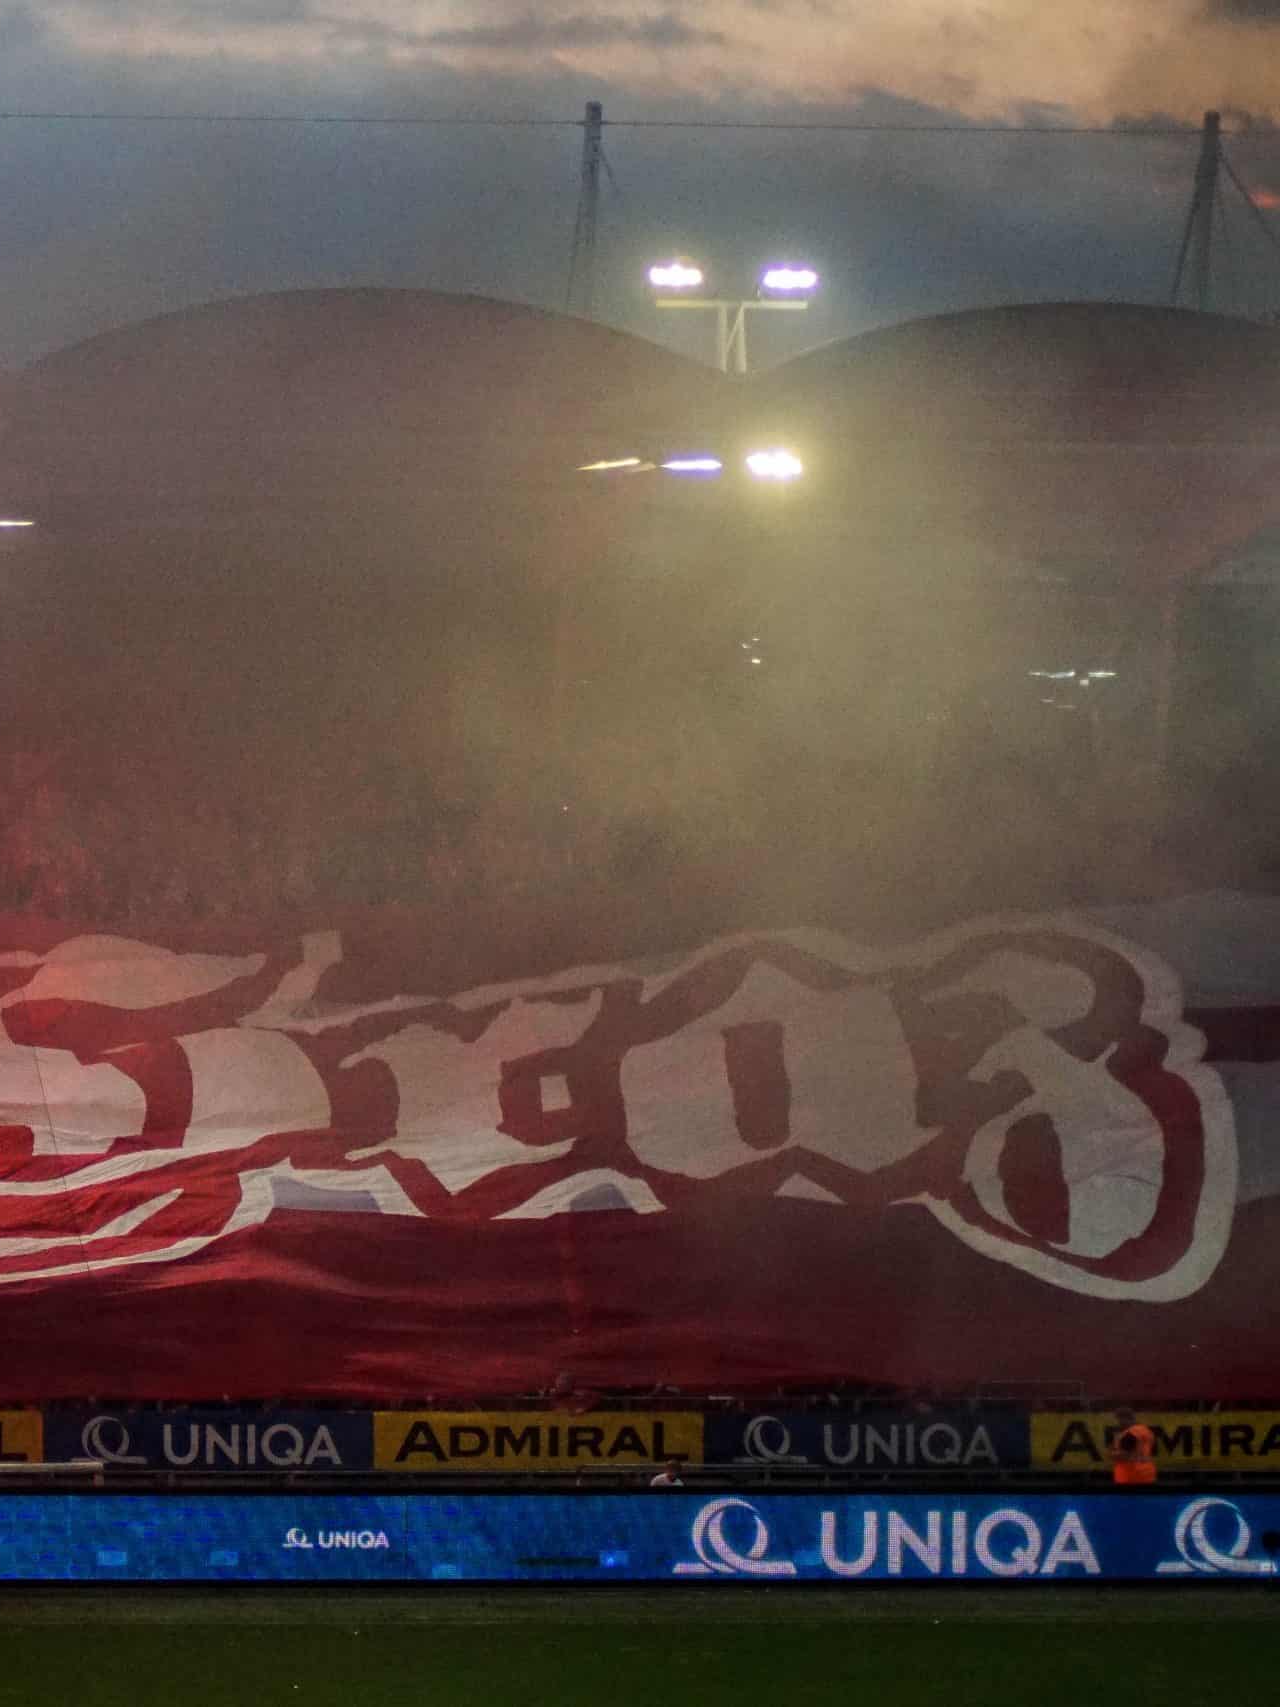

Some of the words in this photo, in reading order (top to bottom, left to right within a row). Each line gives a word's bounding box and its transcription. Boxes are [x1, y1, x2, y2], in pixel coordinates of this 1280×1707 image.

[163, 1423, 343, 1466] UNIQA
[394, 1420, 689, 1462] ADMIRAL
[822, 1423, 999, 1466] UNIQA
[1051, 1420, 1280, 1462] AMIRA
[318, 1529, 390, 1550] UNIQA
[821, 1508, 1102, 1577] UNIQA
